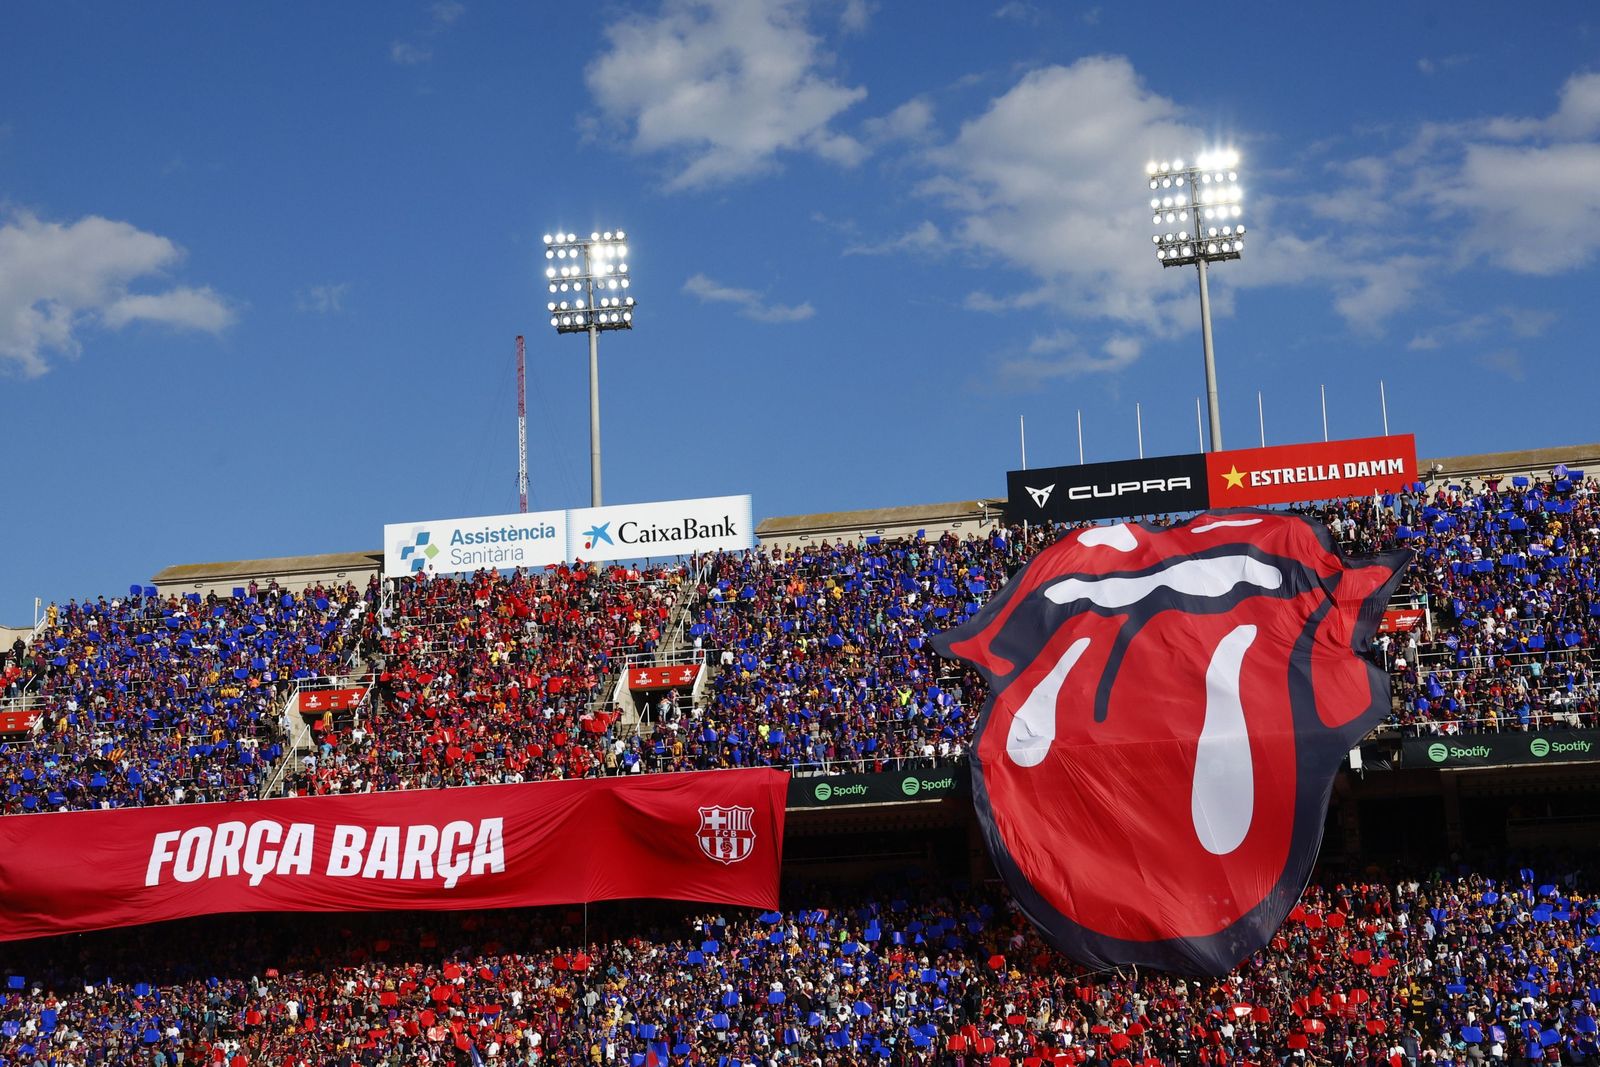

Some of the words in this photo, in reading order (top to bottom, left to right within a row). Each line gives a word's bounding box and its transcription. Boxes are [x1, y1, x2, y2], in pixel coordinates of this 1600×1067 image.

[1250, 464, 1341, 487] ESTRELLA
[1344, 457, 1404, 479] DAMM
[1068, 476, 1192, 500] CUPRA
[450, 523, 556, 546] Assistència
[617, 515, 738, 545] CaixaBank
[450, 543, 525, 566] Sanitària
[1450, 745, 1491, 758] Spotify
[1552, 740, 1592, 753] Spotify
[833, 784, 867, 796] Spotify
[921, 778, 957, 791] Spotify
[144, 819, 315, 887] FORÇA
[326, 817, 506, 889] BARÇA
